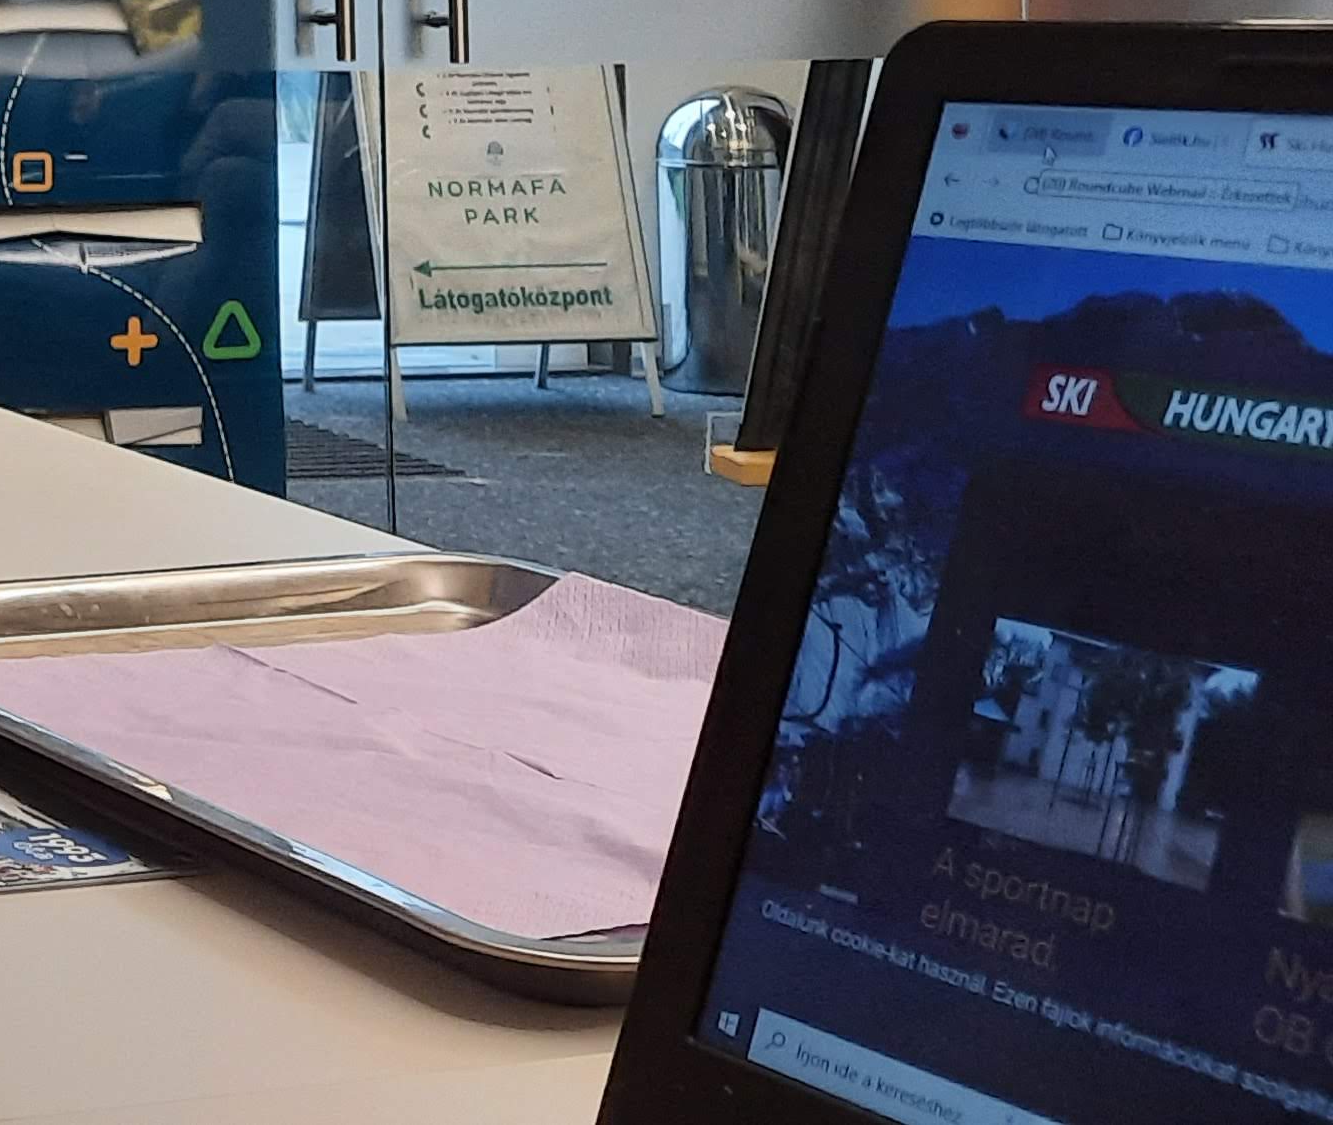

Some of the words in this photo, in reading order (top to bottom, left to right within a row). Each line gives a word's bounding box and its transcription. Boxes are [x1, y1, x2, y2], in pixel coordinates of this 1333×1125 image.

[427, 178, 566, 198] NORMAFA
[464, 207, 540, 225] PARK
[418, 284, 614, 313] Látogatóközpont
[1041, 374, 1098, 416] SKI
[935, 847, 955, 878] A
[964, 860, 1116, 931] sportnap
[861, 1077, 872, 1088] a
